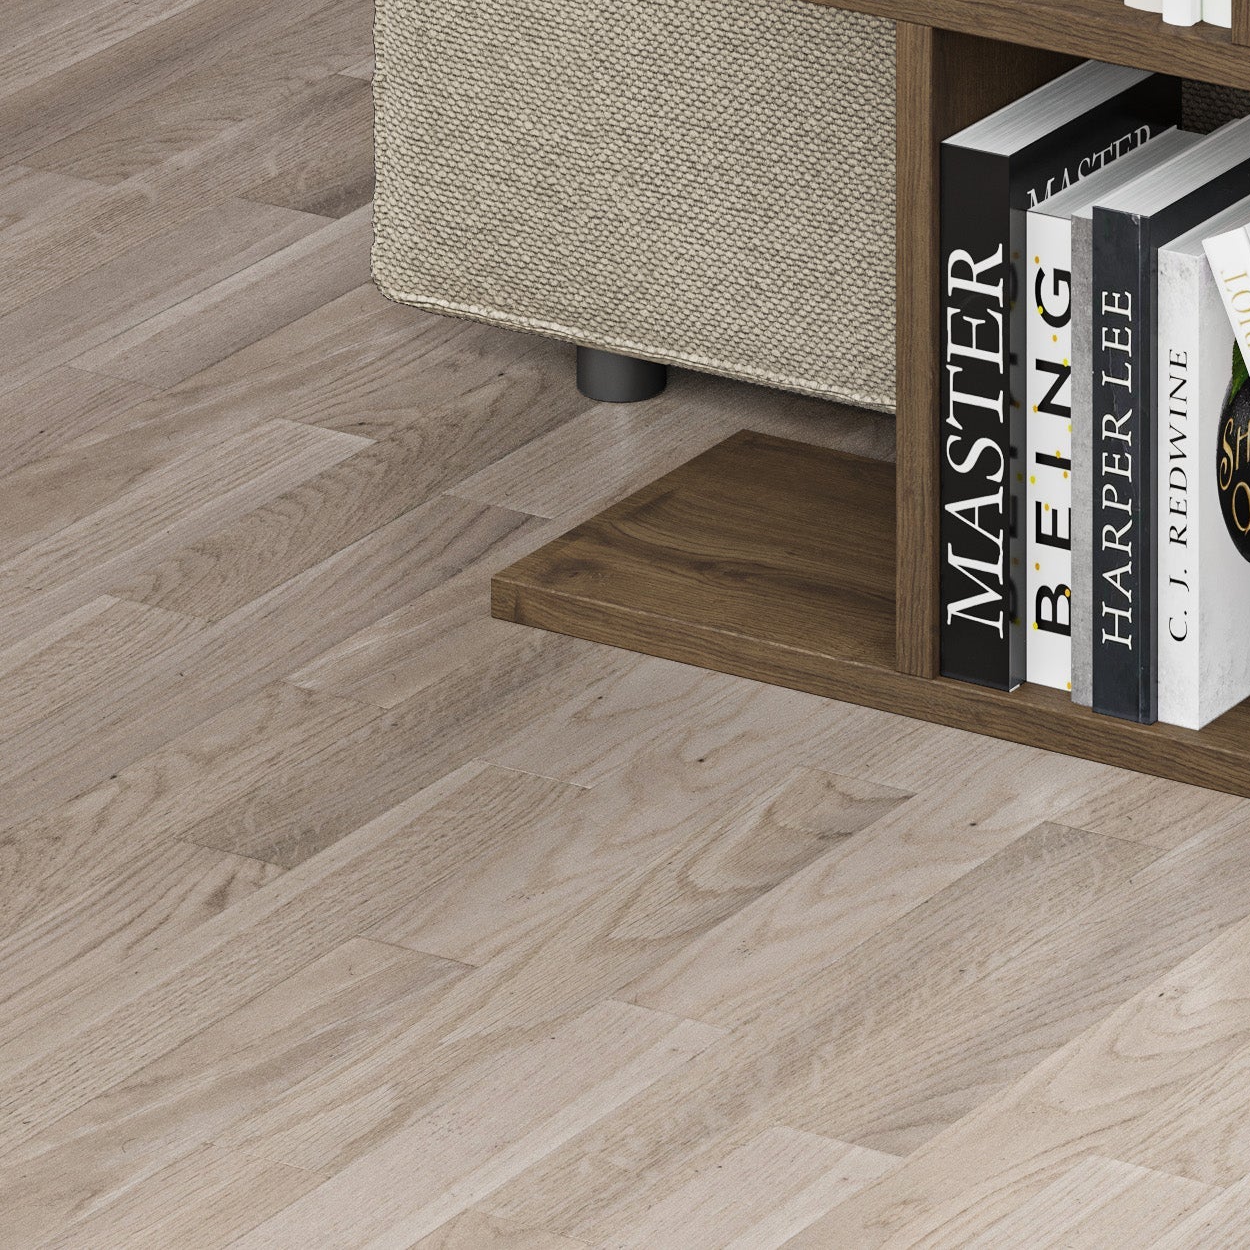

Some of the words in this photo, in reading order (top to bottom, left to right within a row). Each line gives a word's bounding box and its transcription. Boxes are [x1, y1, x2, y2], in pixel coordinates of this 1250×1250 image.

[946, 243, 1004, 639] MASTER
[1101, 291, 1132, 393] LEE
[1035, 267, 1072, 637] BEING
[1101, 409, 1133, 650] HARPER
[1168, 349, 1188, 548] REDWINE
[1168, 568, 1190, 592] J.
[1168, 610, 1188, 642] C.
